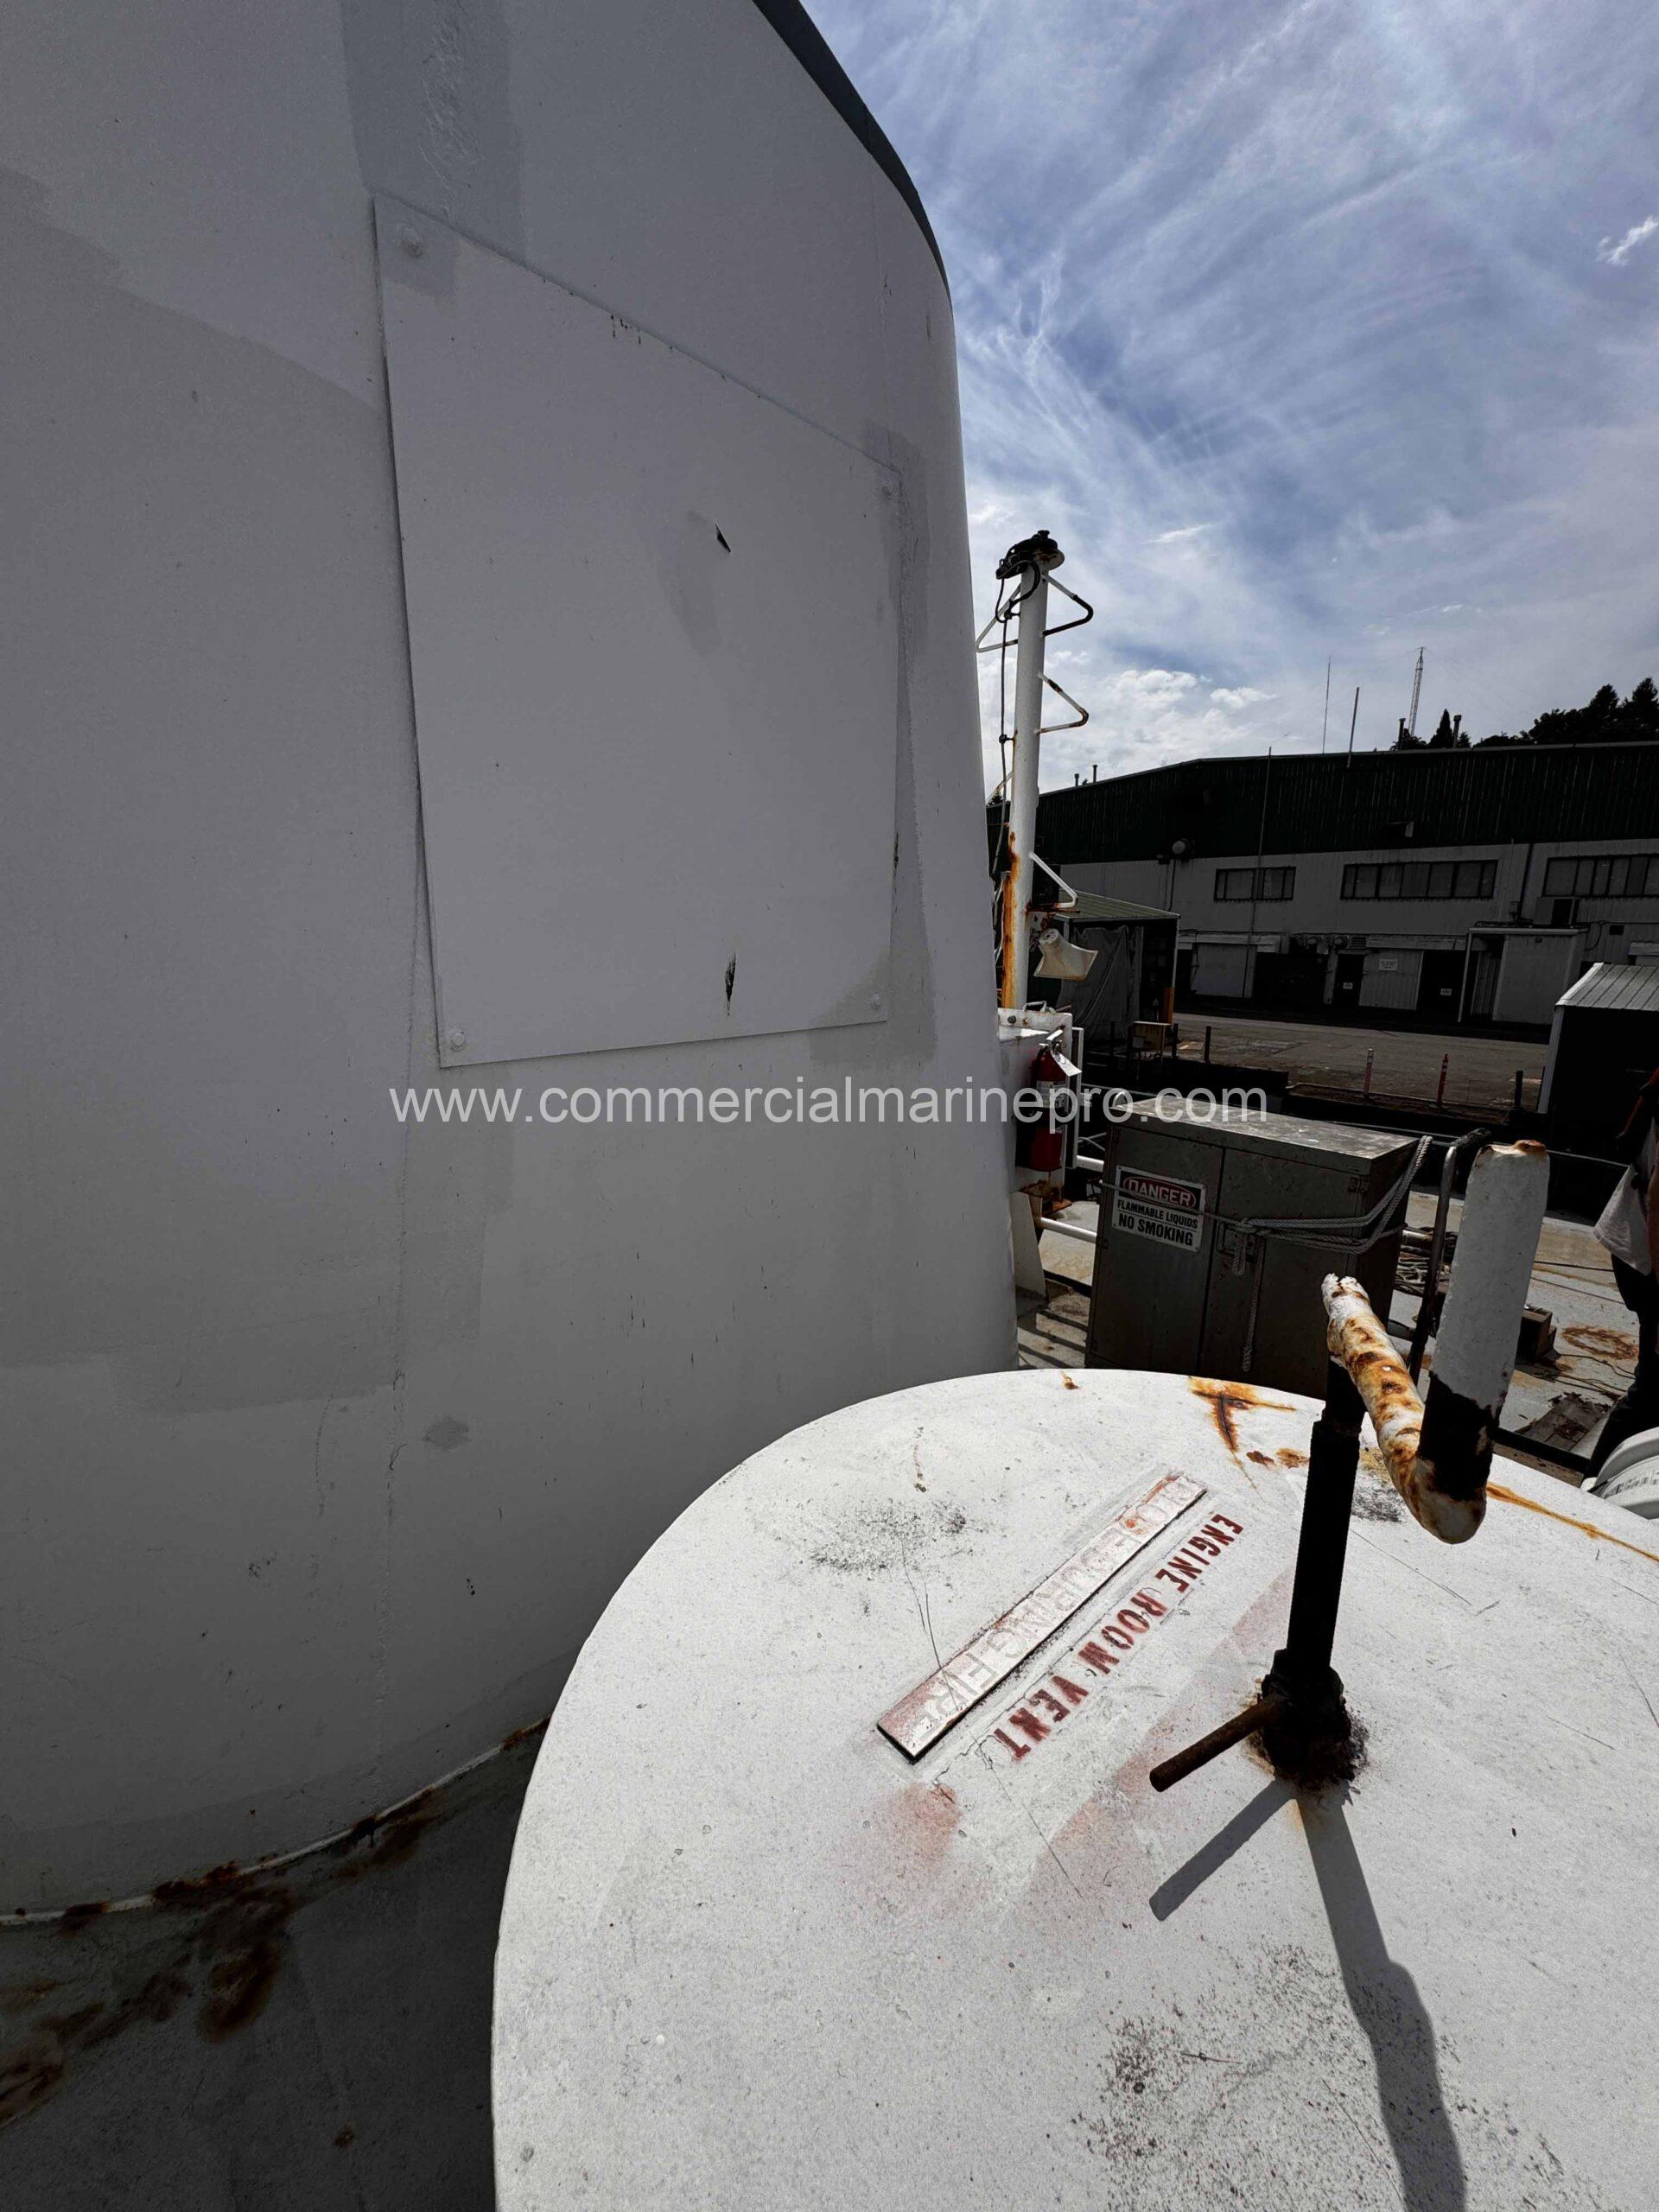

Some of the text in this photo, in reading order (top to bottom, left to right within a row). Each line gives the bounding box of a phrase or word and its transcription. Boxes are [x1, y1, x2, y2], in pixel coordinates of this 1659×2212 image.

[1128, 1179, 1191, 1207] DANGER
[1117, 1199, 1198, 1229] FLAMMABLE LIQUIDS
[1118, 1212, 1193, 1246] NO SMOKING
[994, 1513, 1243, 1762] ENGINE ROOM VENT
